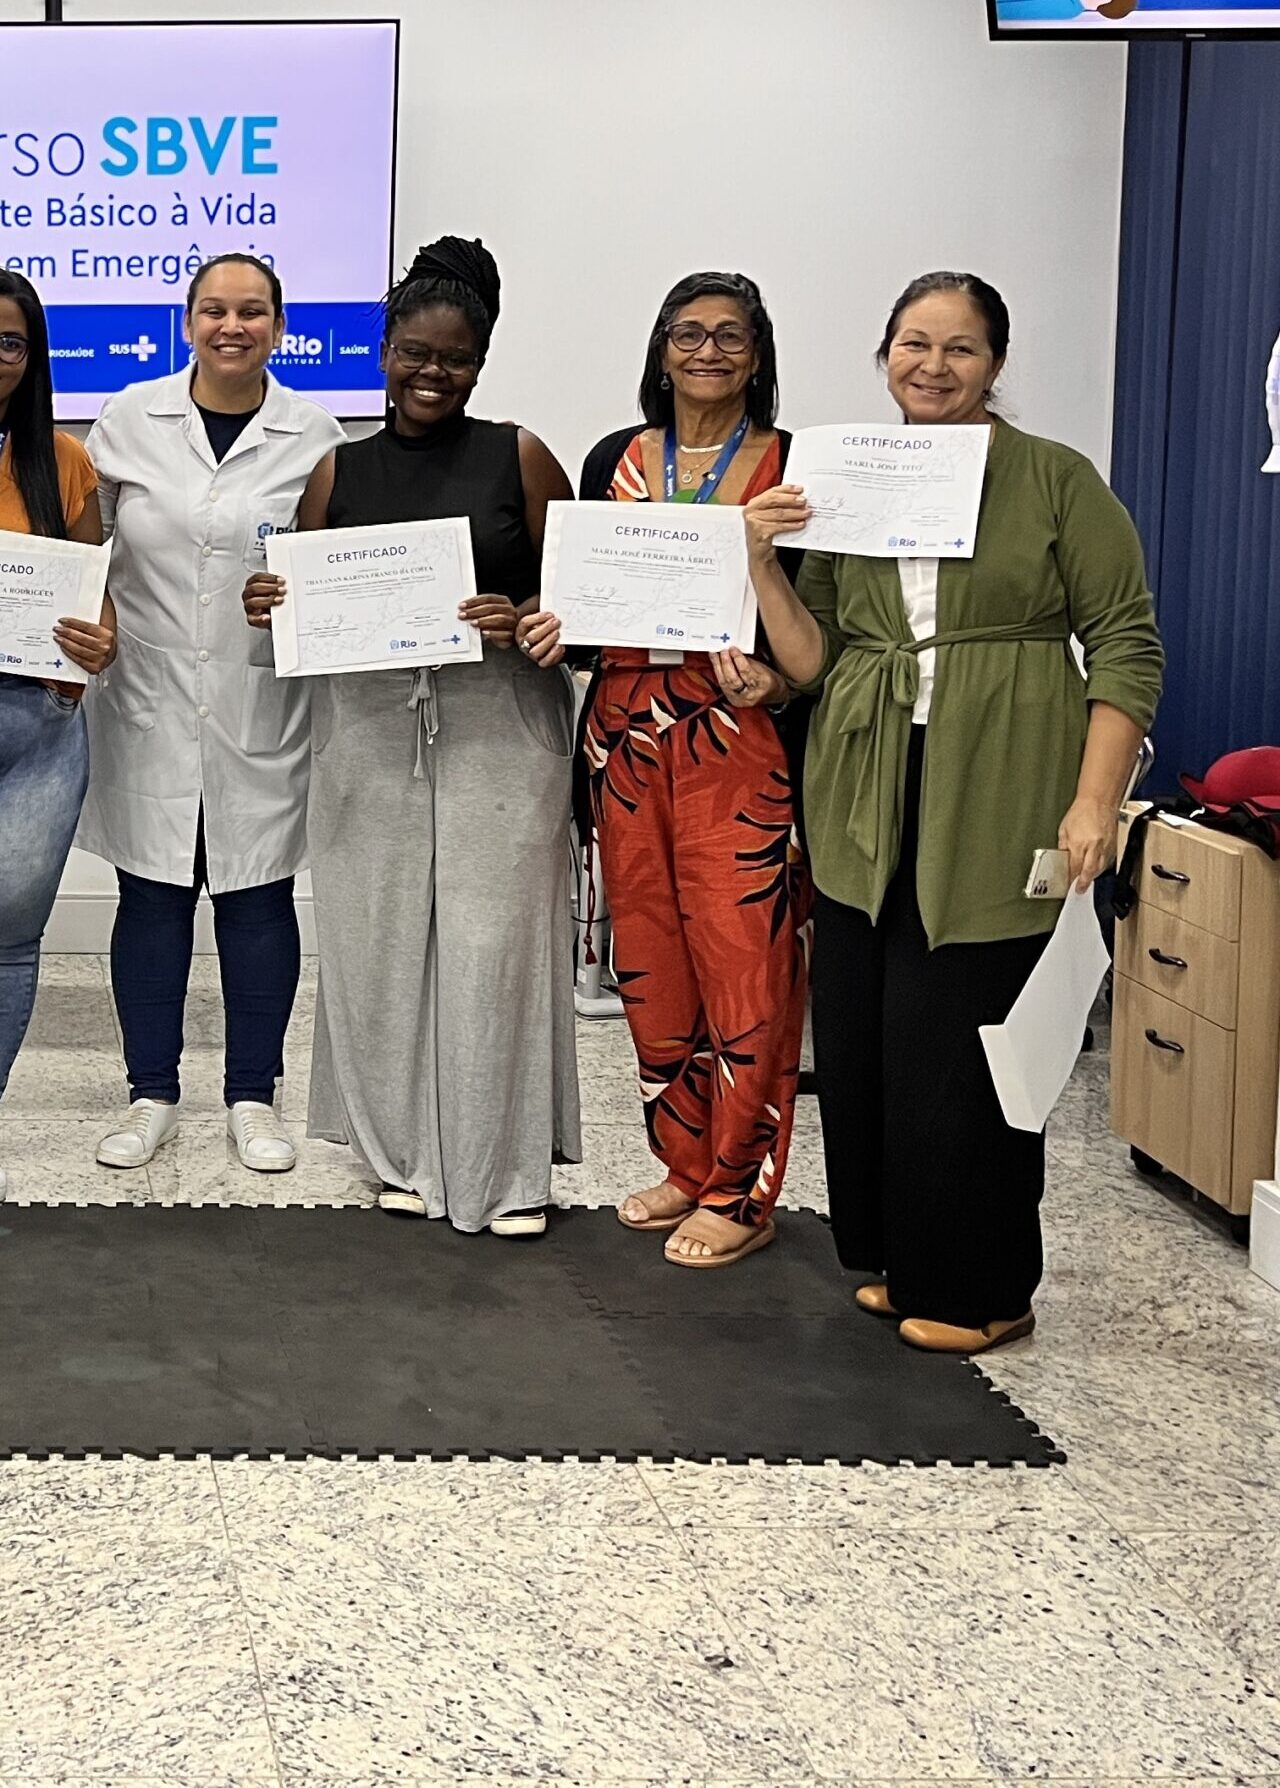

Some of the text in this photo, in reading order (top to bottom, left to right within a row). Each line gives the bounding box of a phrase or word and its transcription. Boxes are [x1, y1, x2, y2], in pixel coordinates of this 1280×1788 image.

[100, 116, 279, 177] SBVE
[47, 192, 158, 228] Básico
[170, 192, 188, 227] à
[200, 192, 277, 227] Vida
[5, 255, 56, 278] em
[109, 343, 130, 355] SUS
[280, 334, 323, 356] Rio
[339, 344, 370, 355] SAÚDE
[842, 436, 932, 450] CERTIFICADO
[615, 525, 700, 542] CERTIFICADO
[899, 538, 917, 547] Rio
[327, 545, 407, 564] CERTIFICADO
[667, 627, 685, 637] Rio
[400, 640, 417, 649] Rio
[6, 655, 23, 664] Rio
